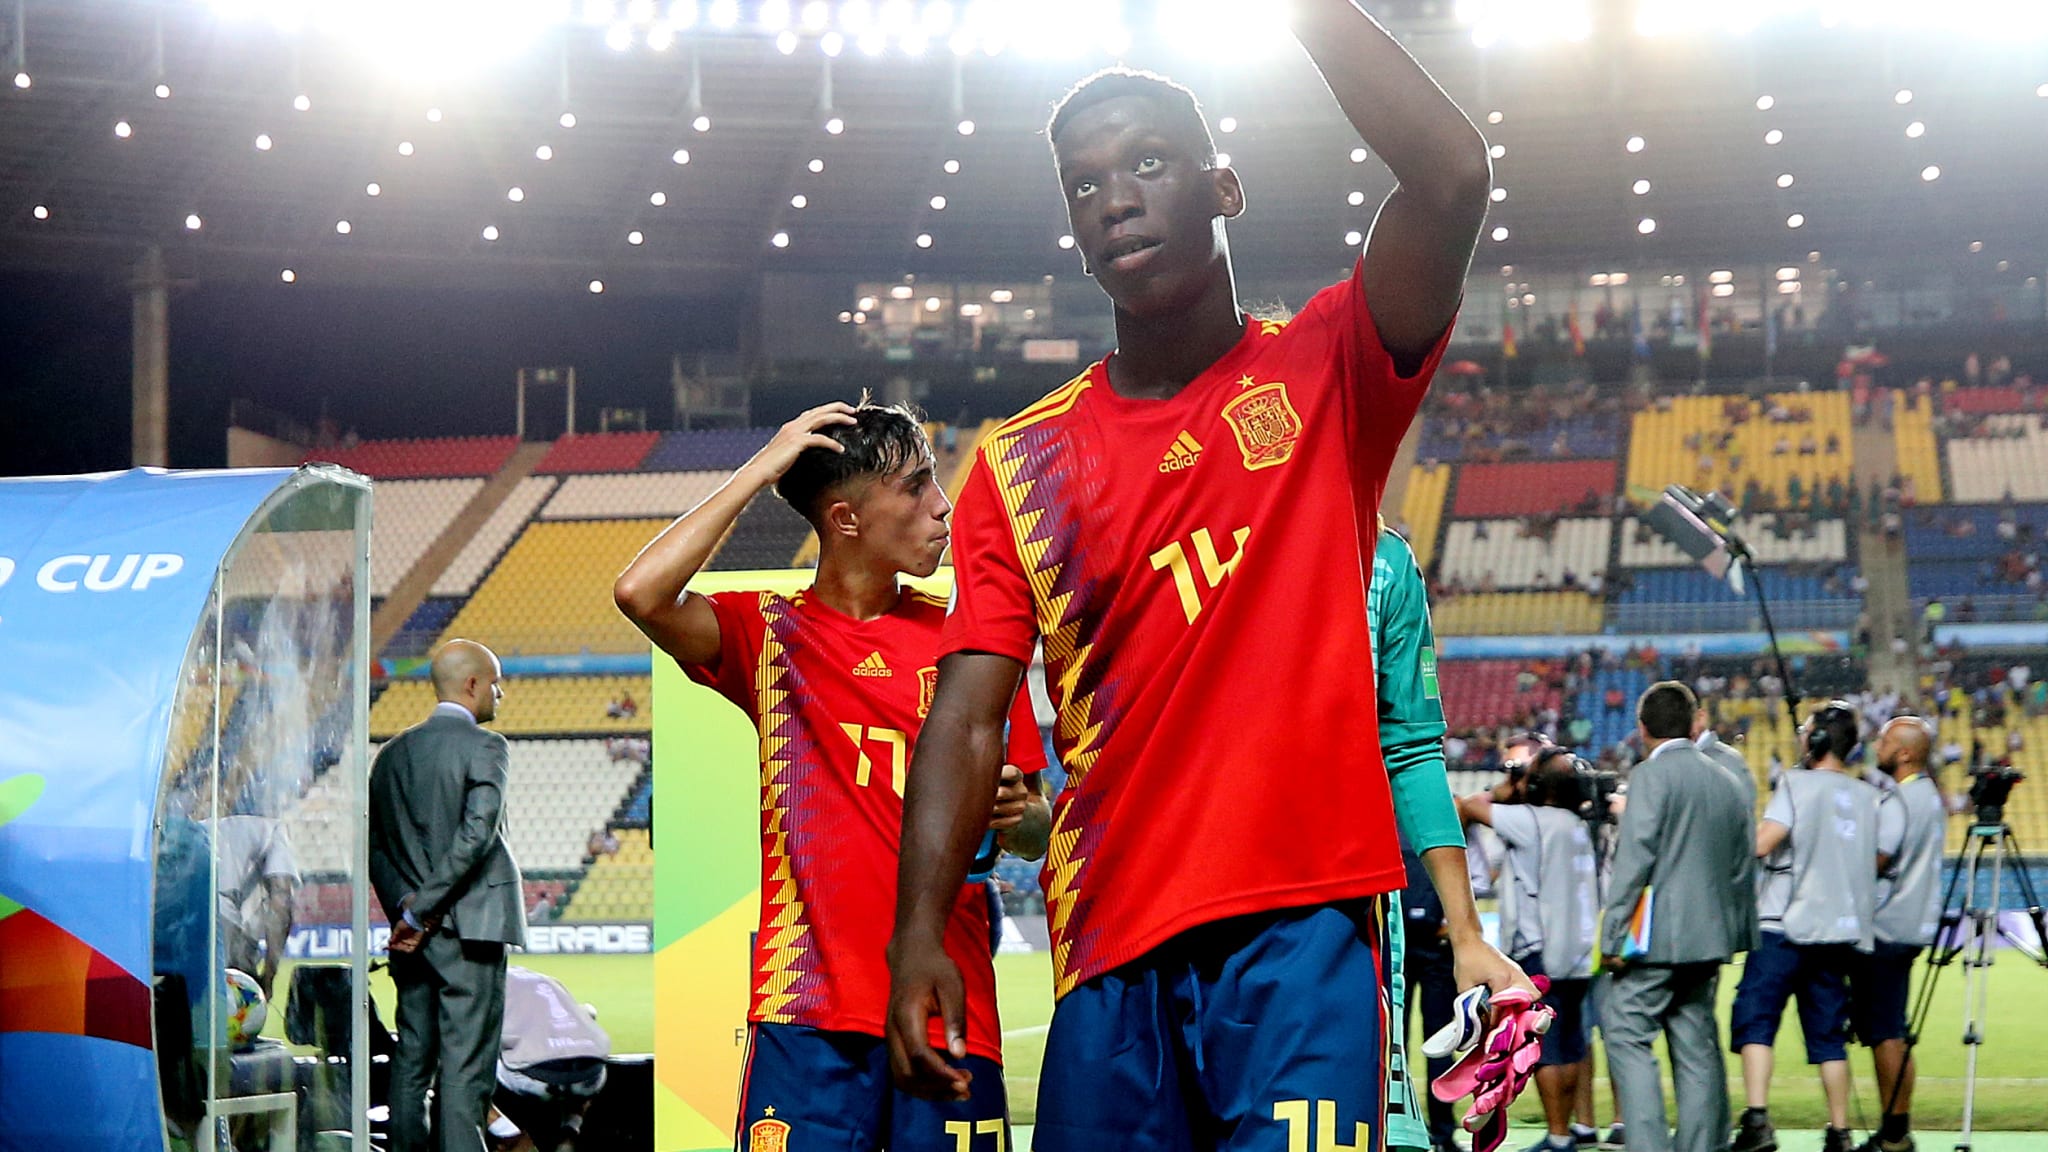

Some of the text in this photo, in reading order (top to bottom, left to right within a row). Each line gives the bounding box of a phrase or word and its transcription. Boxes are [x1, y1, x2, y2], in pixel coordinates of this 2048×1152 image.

[36, 553, 184, 592] CUP
[1150, 526, 1251, 626] 14
[852, 666, 892, 677] adidas
[838, 722, 906, 800] 17
[528, 924, 648, 953] ERADE
[945, 1118, 1005, 1152] 17
[1273, 1099, 1369, 1152] 14
